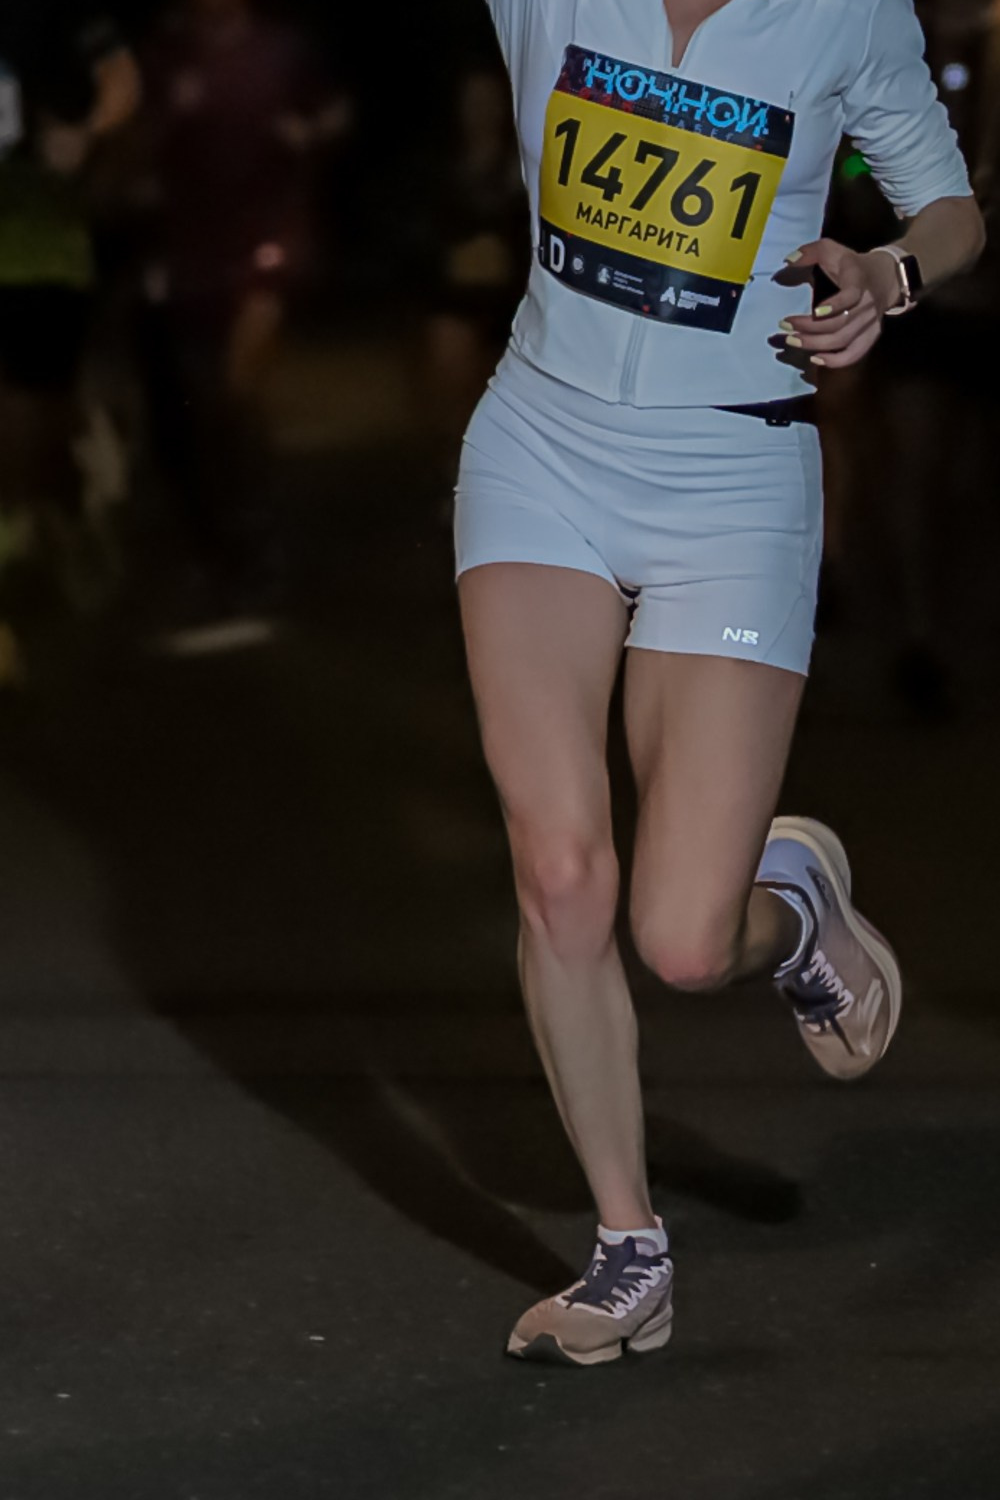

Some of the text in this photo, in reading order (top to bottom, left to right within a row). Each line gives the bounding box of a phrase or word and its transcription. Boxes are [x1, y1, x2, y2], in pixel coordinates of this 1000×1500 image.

[555, 118, 761, 240] 14761
[549, 234, 566, 274] D
[576, 202, 700, 257] МАРГАРИТА
